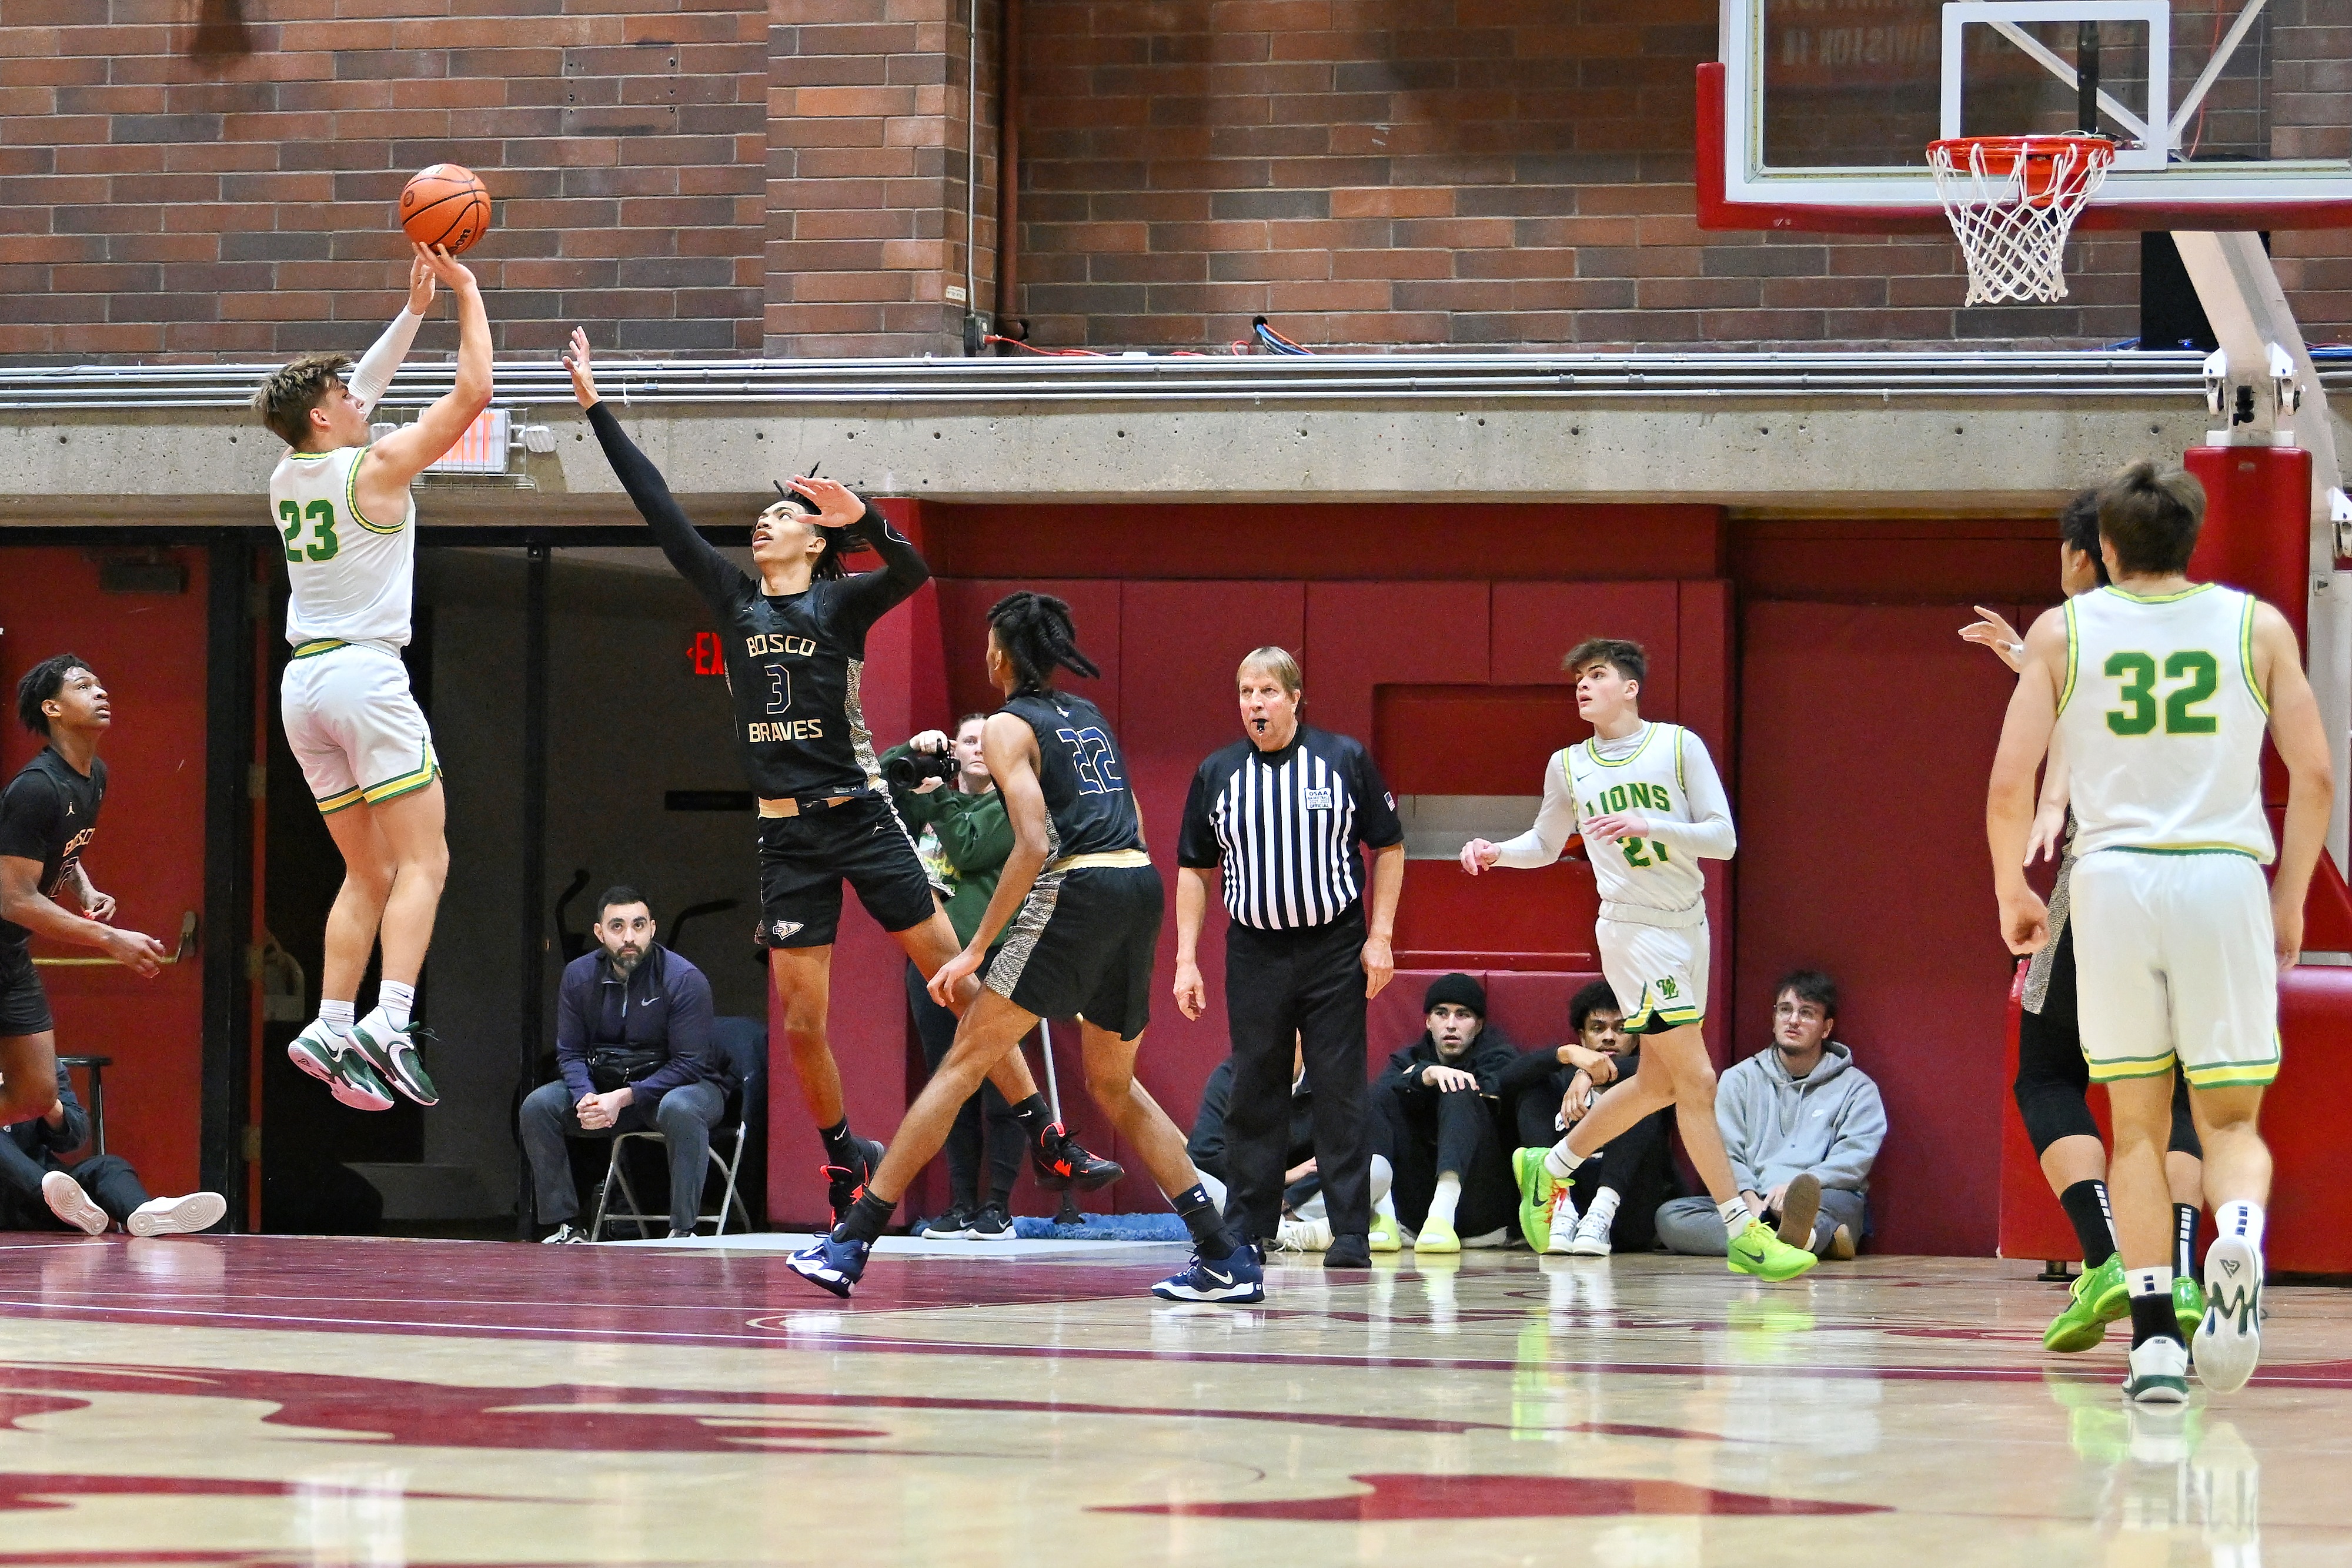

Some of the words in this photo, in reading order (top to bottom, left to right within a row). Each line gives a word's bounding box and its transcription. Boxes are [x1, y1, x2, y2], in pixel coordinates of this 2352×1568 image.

[279, 499, 339, 563] 23
[746, 634, 817, 657] BOSCO
[764, 664, 791, 714] 3
[2103, 650, 2219, 737] 32
[748, 719, 823, 743] BRAVES
[1055, 726, 1124, 796] 22
